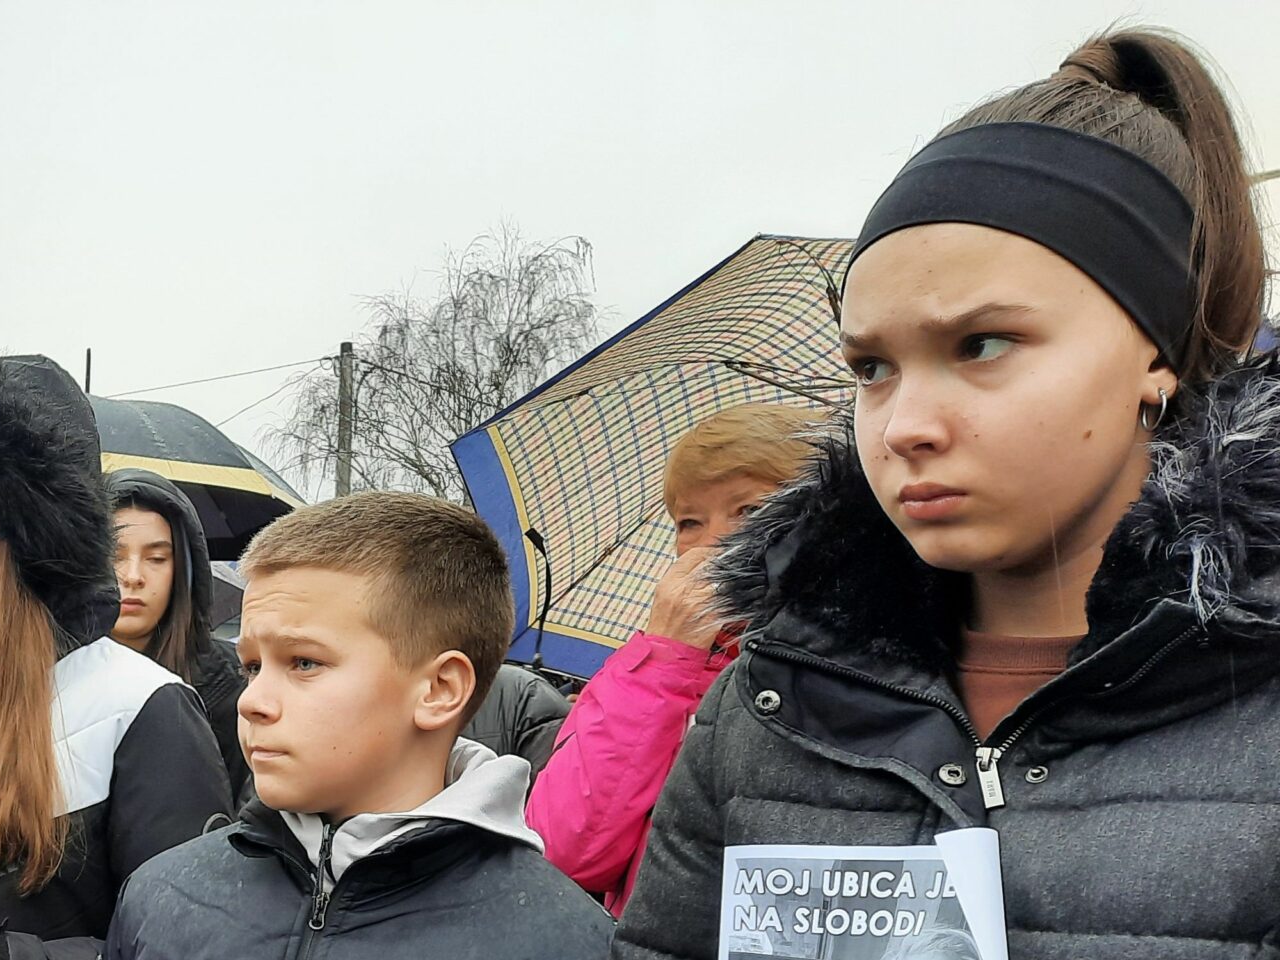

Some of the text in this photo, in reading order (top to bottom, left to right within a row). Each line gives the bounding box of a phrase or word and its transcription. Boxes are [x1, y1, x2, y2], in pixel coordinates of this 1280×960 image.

[734, 868, 811, 896] MOJ
[821, 869, 916, 899] UBICA
[734, 905, 926, 937] NA SLOBODI
